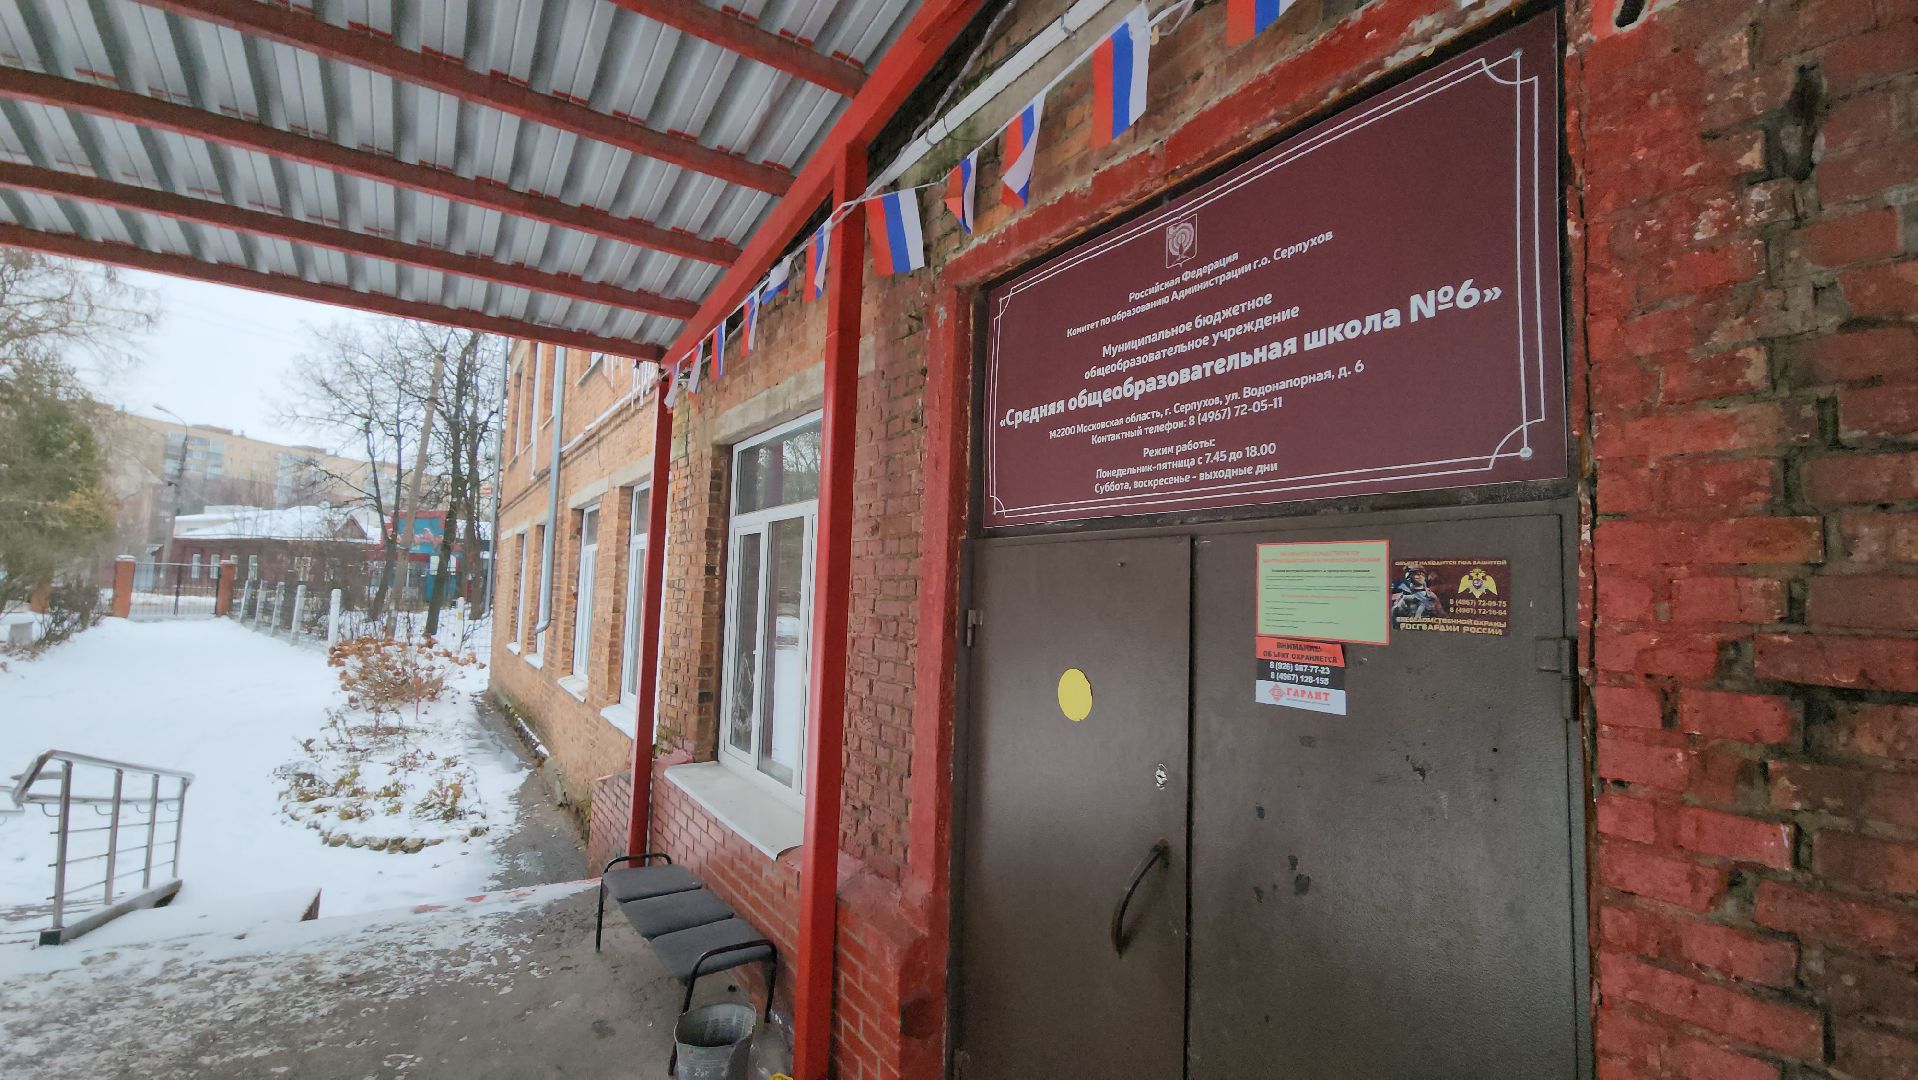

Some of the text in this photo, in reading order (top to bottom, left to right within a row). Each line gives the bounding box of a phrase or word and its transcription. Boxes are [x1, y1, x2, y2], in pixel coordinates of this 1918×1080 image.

[1066, 230, 1334, 338] Комитет по образованию Администрации г.о. Серпухов
[1128, 252, 1239, 302] Российская Федерация
[1084, 305, 1300, 380] общеобразовательное учреждение
[1102, 292, 1273, 358] Муниципальное бюджетное
[1000, 278, 1503, 429] «Средняя общеобразовательная школа №6»
[1076, 416, 1124, 435] Московская
[1125, 409, 1164, 424] область,
[1164, 406, 1172, 416] г.
[1173, 396, 1223, 415] Серпухов,
[1224, 391, 1241, 404] ул.
[1242, 369, 1335, 399] Водонапорная,
[1337, 366, 1352, 379] д.
[1354, 359, 1365, 373] 6
[1091, 396, 1283, 444] Контактный телефон: 8 (4967) 72-05-11
[1096, 442, 1277, 479] Понедельник-пятница с 7.45 до 18.00
[1143, 438, 1216, 458] Режим работы:
[1094, 480, 1132, 495] Суббота,
[1133, 473, 1191, 489] воскресенье
[1199, 464, 1253, 481] выходные
[1254, 462, 1278, 476] дни
[1400, 623, 1503, 636] РОСГВАРДИИ РОССИИ
[1286, 687, 1330, 701] ГАРАНТ
